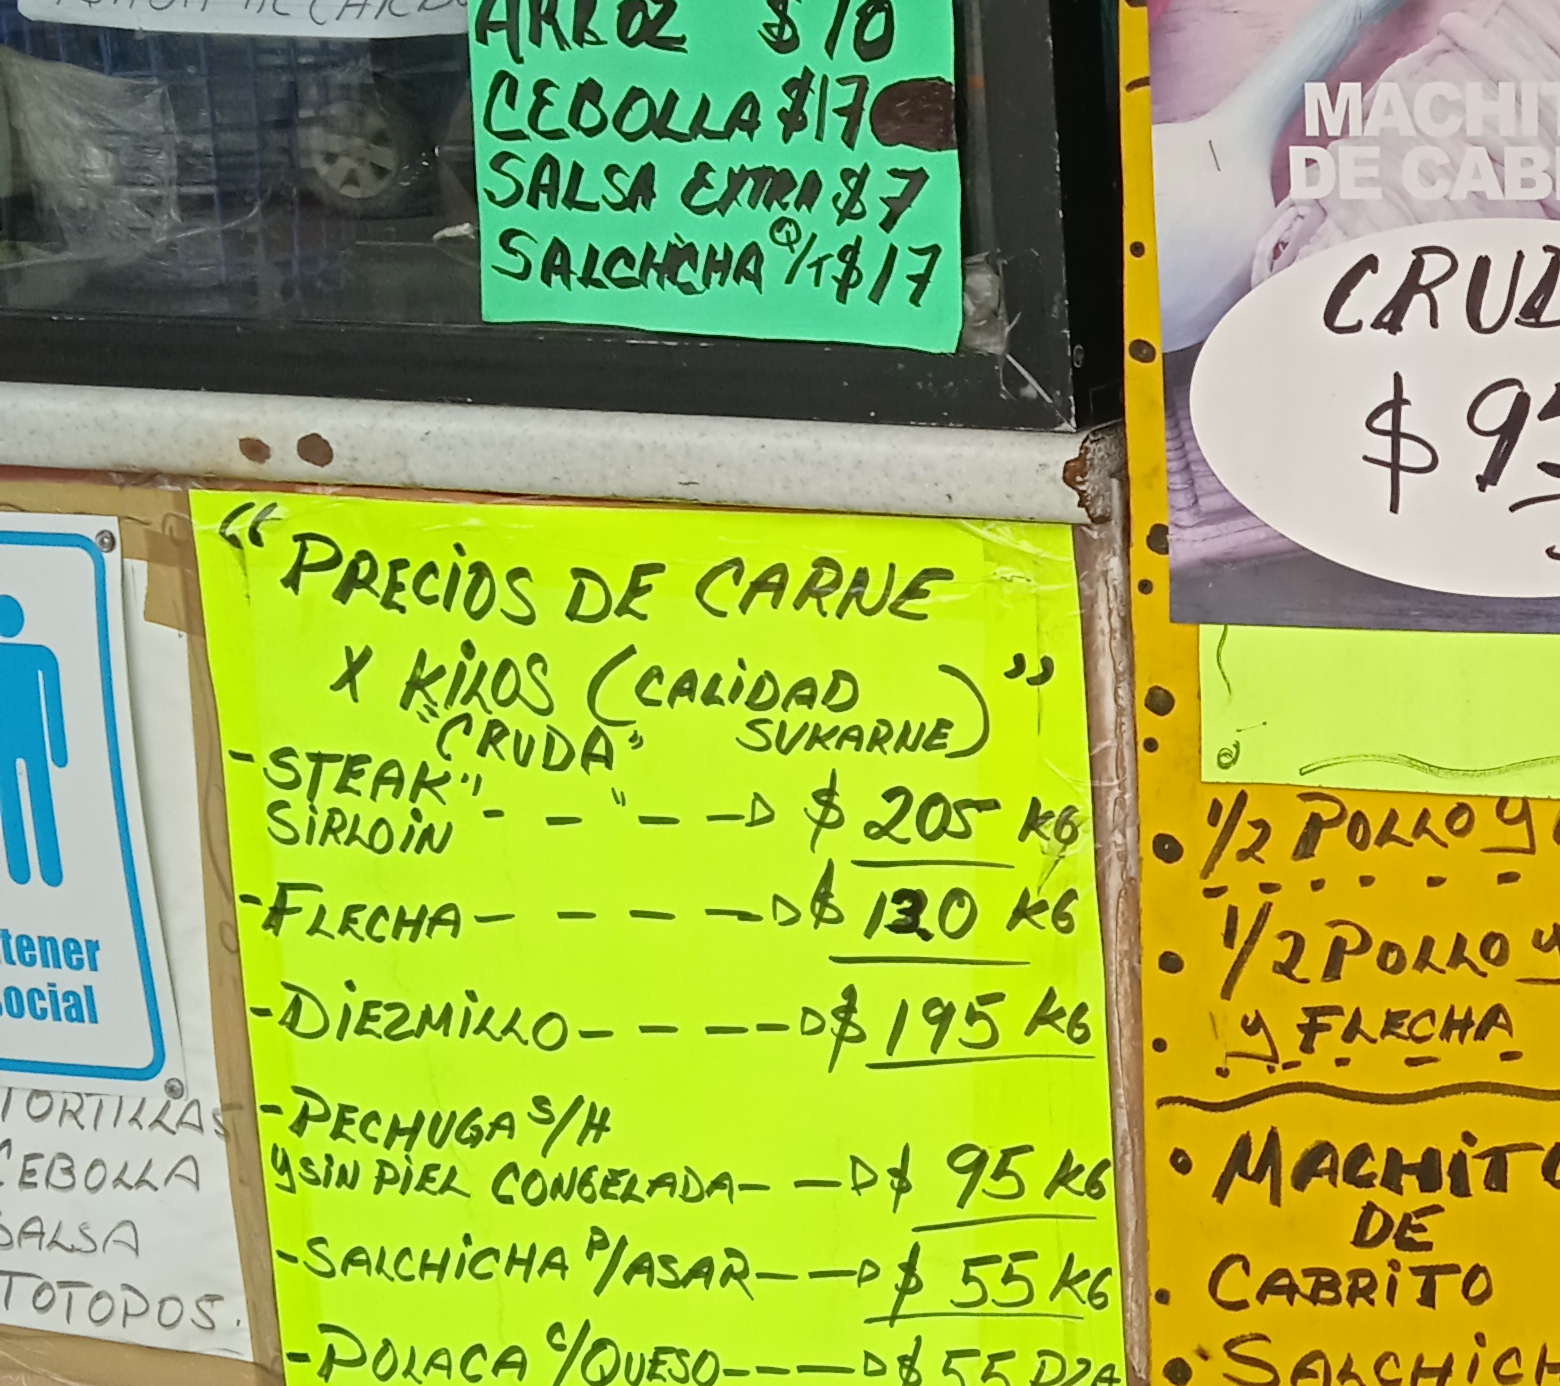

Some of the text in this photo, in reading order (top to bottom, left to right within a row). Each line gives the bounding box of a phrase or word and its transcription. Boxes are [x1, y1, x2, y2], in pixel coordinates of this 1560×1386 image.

[482, 69, 762, 143] CEBOLLA
[484, 151, 656, 212] SALSA
[680, 161, 824, 217] EXTRA
[1288, 145, 1381, 201] DE
[565, 562, 666, 623] DE
[695, 556, 955, 621] CARNE
[330, 644, 374, 703] X
[399, 639, 555, 716] KILOS
[265, 799, 453, 855] SIRLOIN
[1292, 790, 1475, 862] POLLO
[1219, 900, 1309, 1001] 1/2
[1320, 919, 1509, 983] POLLO
[1296, 1002, 1514, 1054] FLECHA
[373, 1154, 472, 1199] PIEL
[490, 1161, 735, 1207] CONGELADA
[1350, 1199, 1445, 1255] DE
[1207, 1253, 1493, 1313] CABRITO
